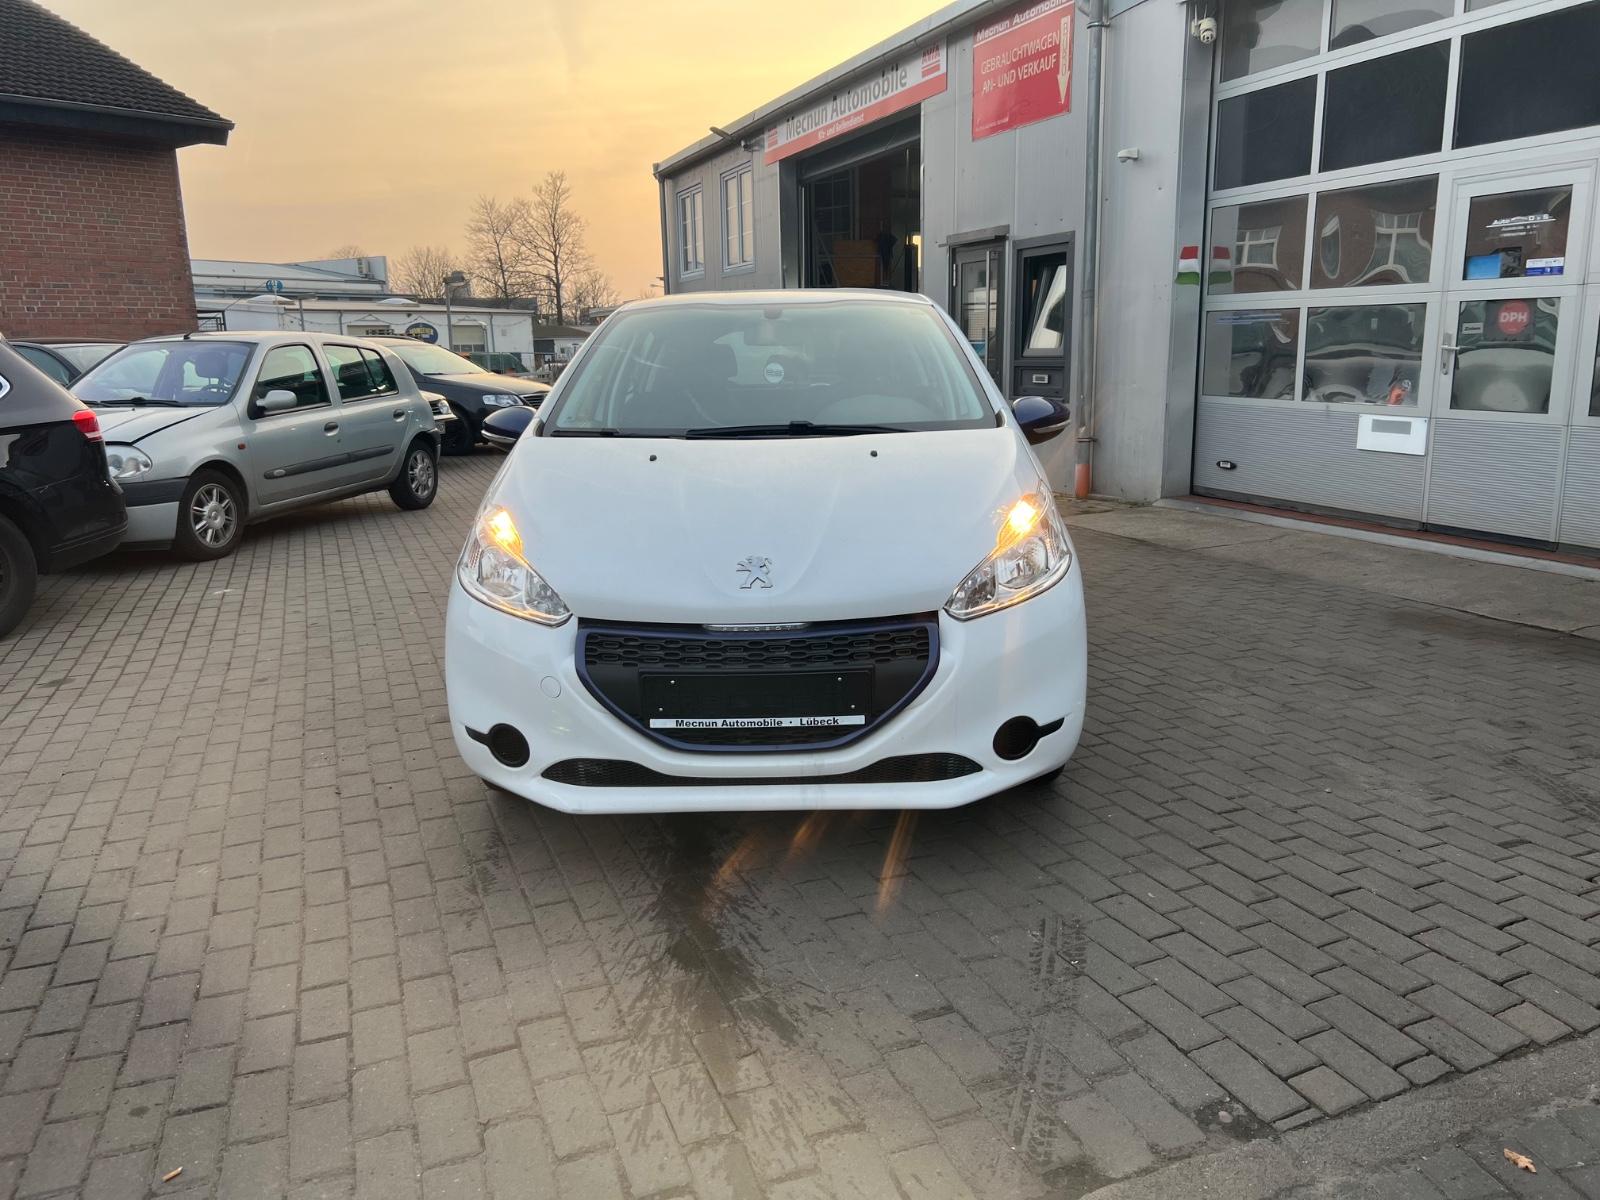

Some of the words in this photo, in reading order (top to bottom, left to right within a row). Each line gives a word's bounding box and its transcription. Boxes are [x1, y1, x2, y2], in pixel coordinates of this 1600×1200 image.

[976, 19, 1010, 42] Mecnun
[1013, 0, 1069, 26] Automob
[981, 30, 1060, 75] GEBRAUCHTWAGEN
[982, 79, 996, 95] AN-
[997, 69, 1016, 88] UND
[1017, 53, 1057, 81] VERKAUF
[785, 104, 828, 141] Mecnun
[830, 63, 908, 121] Automobile
[1500, 311, 1528, 323] DPH
[675, 719, 718, 728] Mecnun
[721, 718, 783, 728] Automobile
[800, 716, 840, 726] Lübeck
